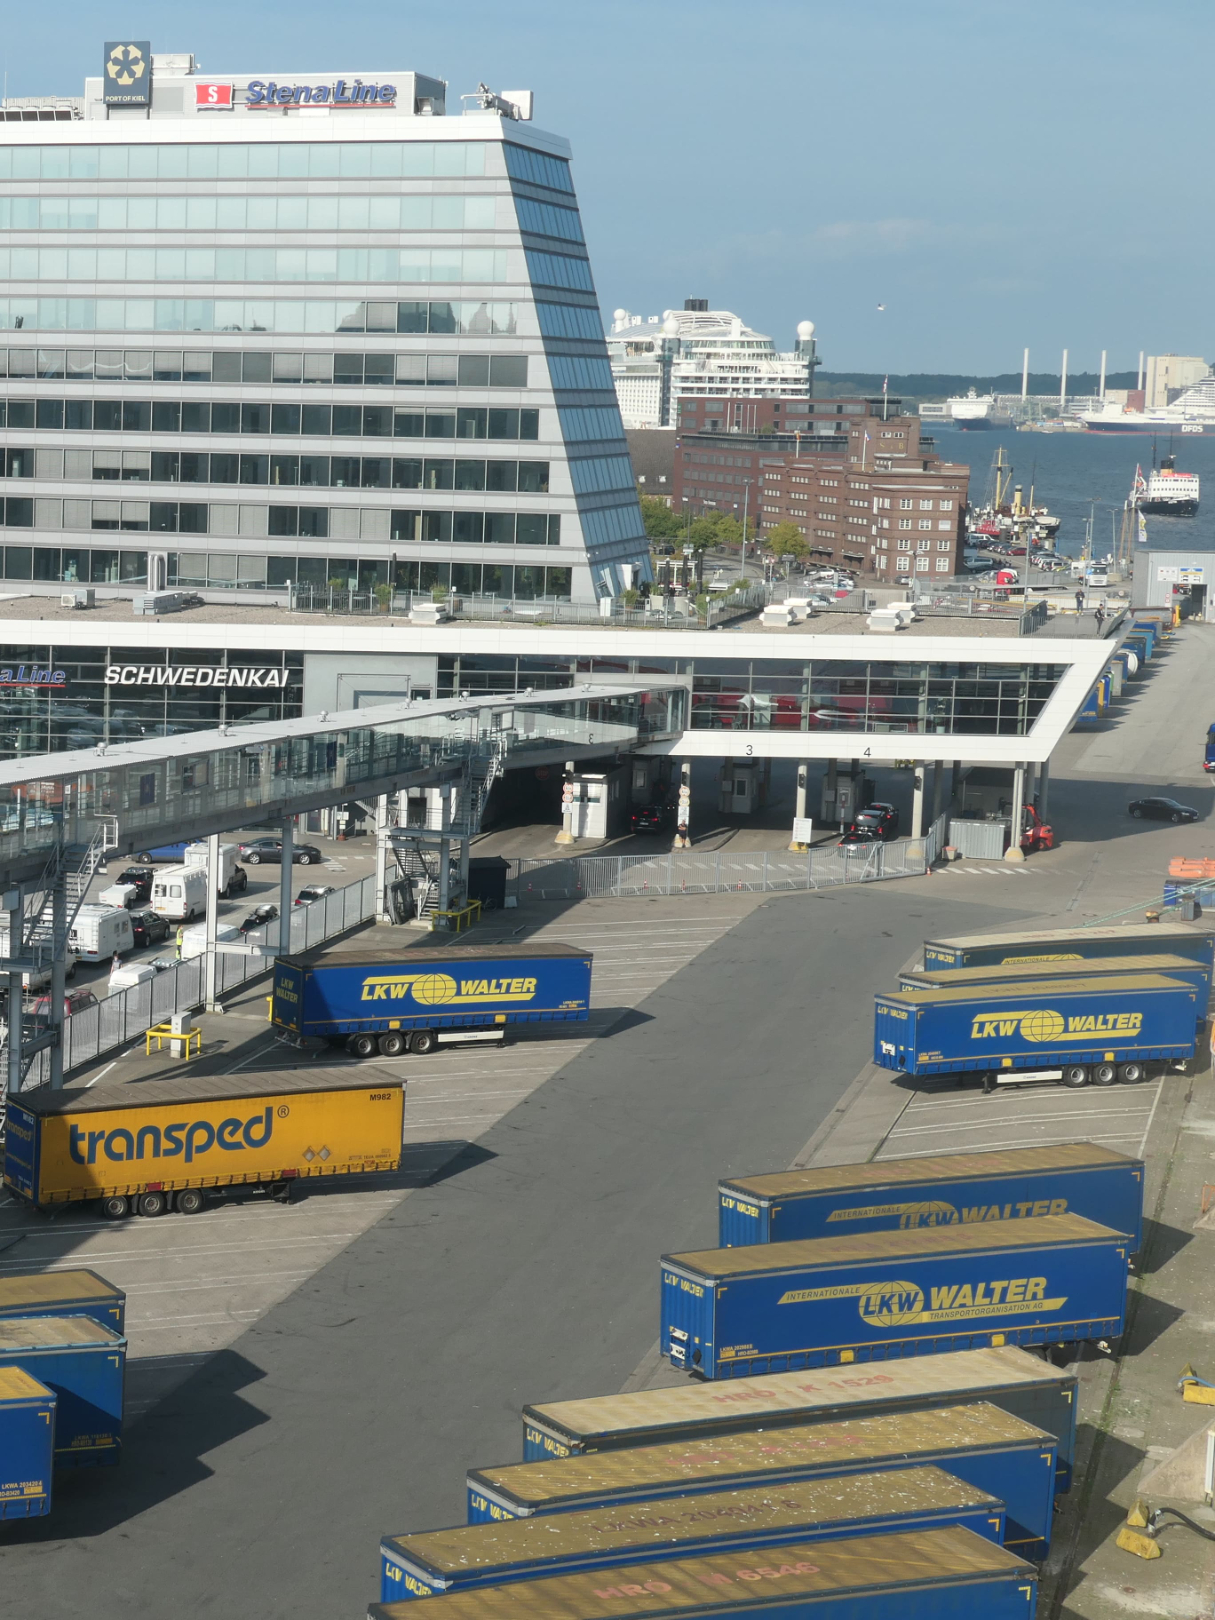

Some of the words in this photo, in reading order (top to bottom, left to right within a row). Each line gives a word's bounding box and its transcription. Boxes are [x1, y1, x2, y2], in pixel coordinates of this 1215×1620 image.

[245, 80, 330, 103] Stena
[335, 79, 396, 102] Line
[17, 665, 66, 683] Line
[104, 666, 289, 687] SCHWEDENKAI
[746, 744, 753, 756] 3
[863, 747, 871, 757] 4
[281, 977, 294, 990] LKW
[361, 983, 410, 1000] LKW
[460, 977, 538, 995] WALTER
[276, 987, 299, 1004] WALTER
[877, 1006, 889, 1015] LKW
[890, 1009, 908, 1020] WALTER
[971, 1020, 1018, 1039] LKW
[1068, 1013, 1143, 1032] WALTER
[369, 1093, 391, 1101] M982
[70, 1106, 274, 1165] transped
[722, 1196, 735, 1209] LKW
[736, 1202, 759, 1218] WALTER
[834, 1205, 902, 1220] INTERNATIONALE
[961, 1199, 1069, 1223] WALTER
[664, 1272, 679, 1286] LKW
[680, 1278, 704, 1298] WALTER
[787, 1286, 861, 1301] INTERNATIONALE
[930, 1277, 1047, 1310] WALTER
[862, 1291, 920, 1317] LKW
[930, 1304, 1031, 1320] TRANSPORTORGANISATION
[1032, 1302, 1043, 1310] AG
[712, 1390, 777, 1403] HRO
[797, 1383, 822, 1393] K
[828, 1374, 894, 1389] 1529
[527, 1428, 542, 1444] LKW
[544, 1436, 570, 1457] WALTER
[471, 1494, 487, 1512] LKW
[490, 1503, 514, 1520] WALT
[590, 1515, 681, 1534] LKWA
[386, 1563, 402, 1581] LKW
[736, 1562, 820, 1581] 6546
